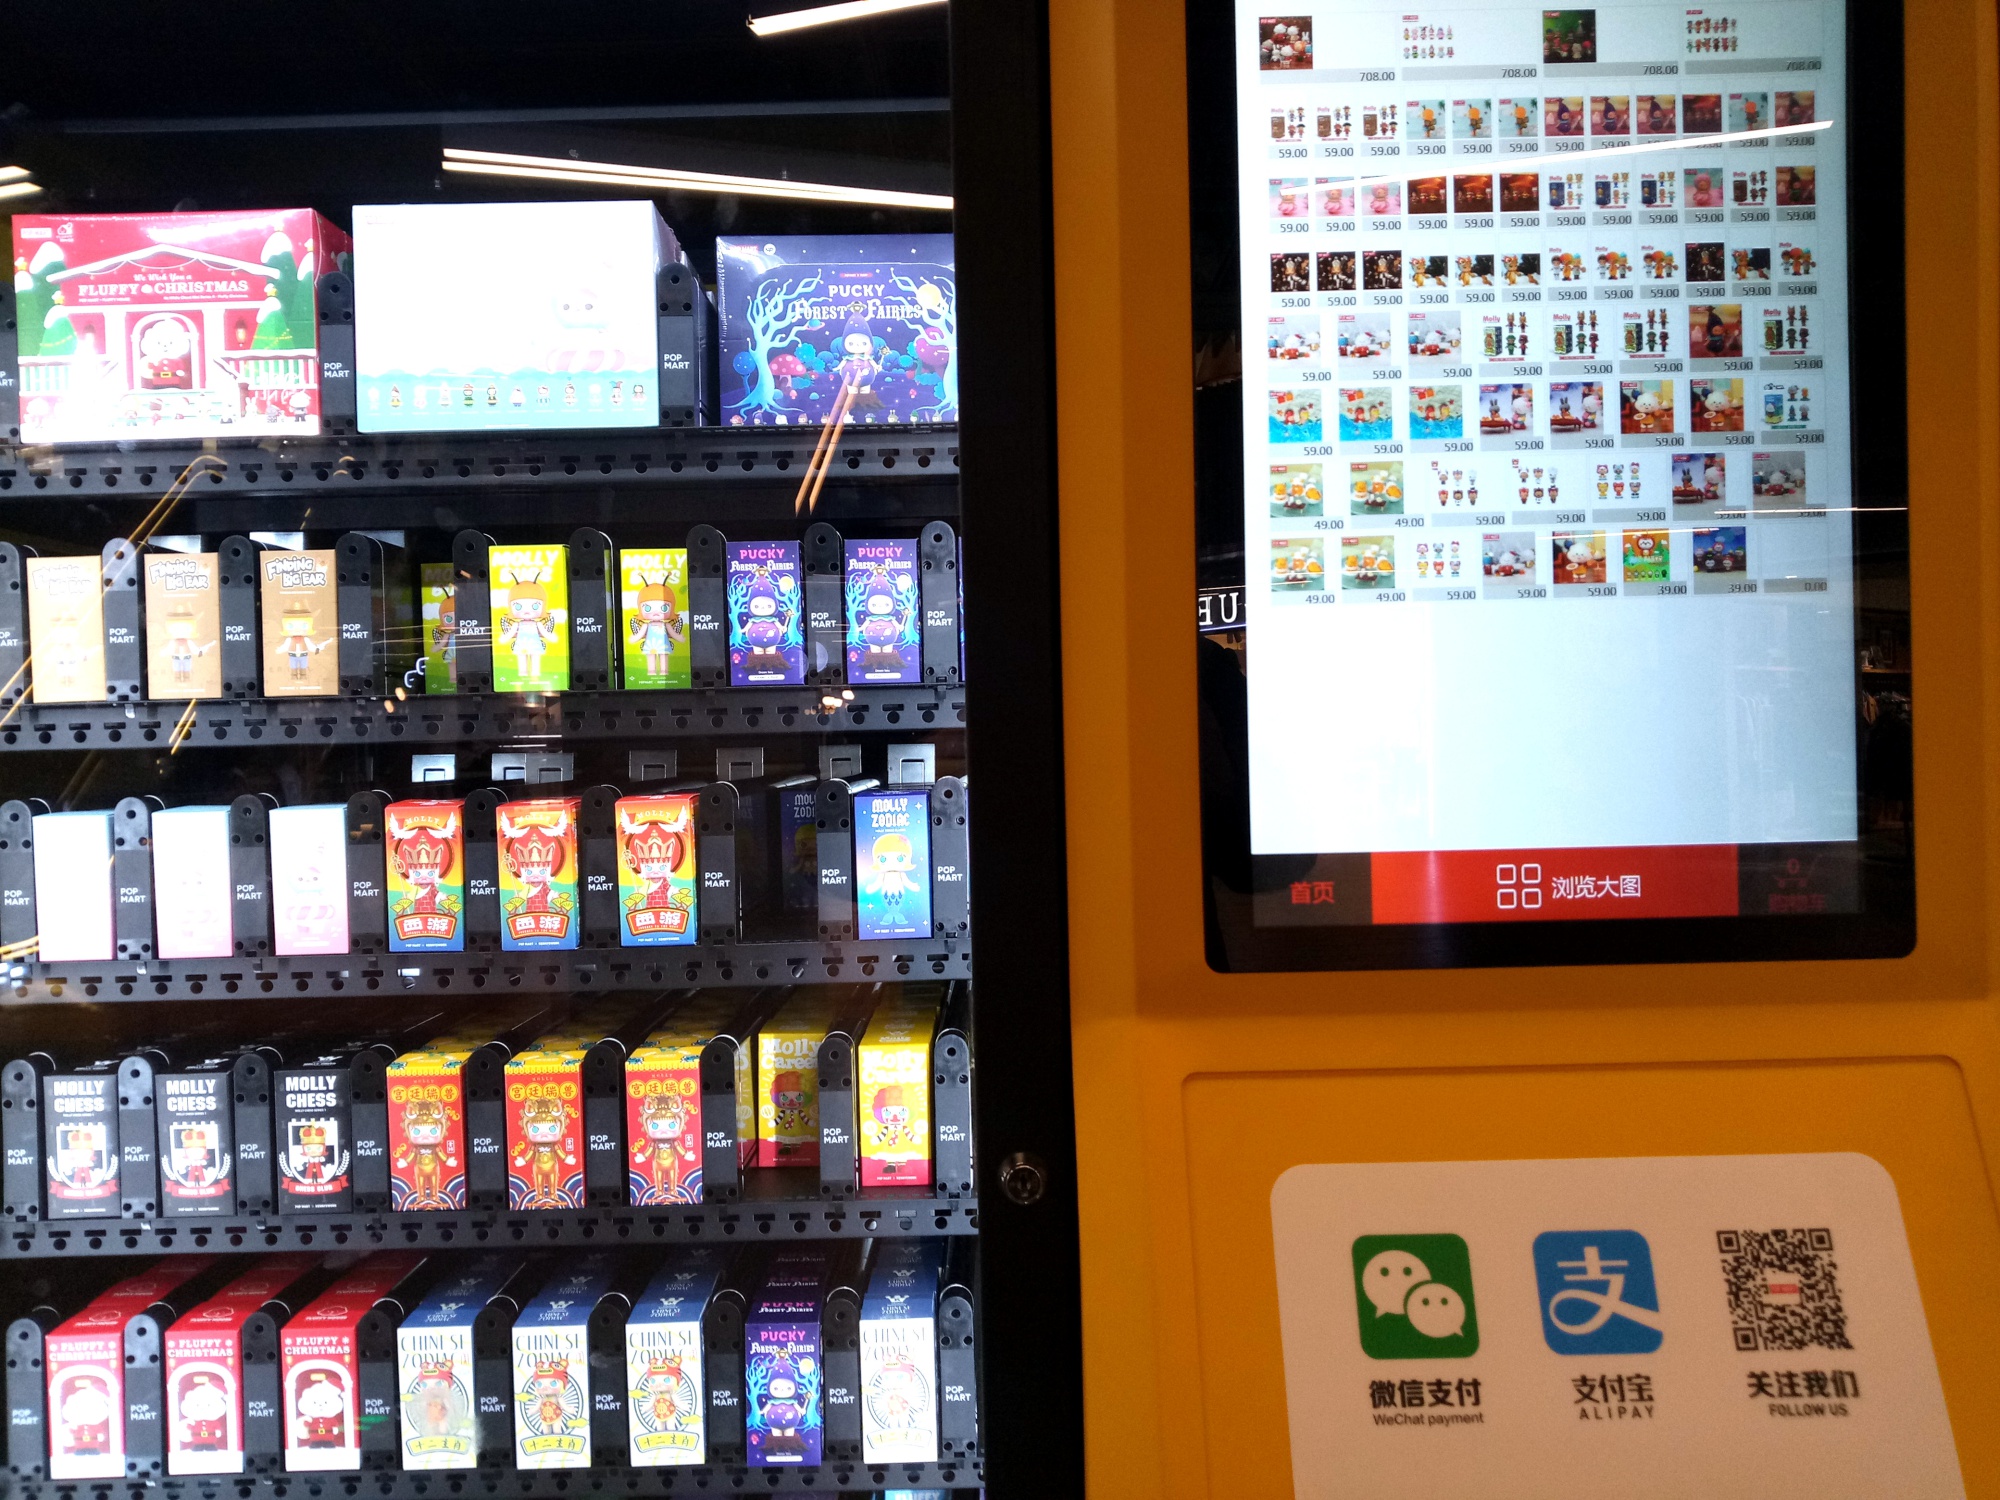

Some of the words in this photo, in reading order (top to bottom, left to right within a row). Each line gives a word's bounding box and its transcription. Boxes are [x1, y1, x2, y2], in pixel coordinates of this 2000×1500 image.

[1643, 65, 1679, 75] 708.00
[1786, 60, 1822, 71] 708.00
[1359, 72, 1395, 82] 708.00
[1501, 68, 1537, 78] 708.00
[1785, 136, 1815, 146] 59.00
[1278, 148, 1308, 158] 59.00
[1417, 145, 1446, 155] 59.00
[1464, 218, 1494, 228] 59.00
[1649, 214, 1678, 224] 59.00
[1280, 223, 1309, 233] 59.00
[78, 284, 139, 296] FLUFFY
[154, 280, 248, 294] CHRISTMAS
[828, 284, 885, 297] PUCKY
[1696, 287, 1725, 297] 59.00
[1281, 297, 1310, 308] 59.00
[1419, 294, 1449, 304] 59.00
[791, 299, 848, 321] FOREST
[866, 298, 923, 321] FAIRIES
[664, 353, 682, 362] POP
[324, 362, 342, 370] POP
[664, 361, 690, 370] MART
[1583, 364, 1613, 374] 59.00
[1794, 359, 1823, 369] 59.00
[324, 370, 349, 379] MART
[1372, 369, 1402, 379] 59.00
[1795, 433, 1824, 443] 59.00
[1514, 440, 1544, 450] 59.00
[1303, 446, 1333, 456] 59.00
[1314, 519, 1344, 530] 49.00
[1394, 517, 1425, 528] 49.00
[739, 549, 785, 559] PUCKY
[858, 547, 902, 558] PUCKY
[491, 551, 558, 567] MOLLY
[621, 553, 687, 569] MOLLY
[730, 560, 757, 572] FOREST
[767, 560, 794, 571] FAIRIES
[848, 558, 875, 571] FOREST
[884, 558, 912, 570] FAIRIES
[185, 574, 210, 589] EAR
[302, 571, 326, 587] EAR
[1658, 585, 1687, 595] 39.00
[1728, 583, 1757, 593] 39.00
[1804, 582, 1827, 592] 0.00
[1376, 592, 1406, 602] 49.00
[1517, 588, 1547, 599] 59.00
[1305, 594, 1335, 604] 49.00
[693, 614, 712, 623] POP
[927, 611, 945, 619] POP
[576, 617, 595, 625] POP
[693, 621, 719, 630] MART
[927, 618, 953, 626] MART
[225, 625, 244, 634] POP
[342, 624, 361, 632] POP
[576, 624, 602, 633] MART
[225, 632, 251, 641] MART
[342, 631, 368, 639] MART
[871, 798, 908, 814] MOLLY
[516, 813, 551, 824] MOLLY
[636, 809, 672, 820] MOLLY
[871, 811, 910, 828] ZODIAC
[405, 814, 440, 826] MOLLY
[704, 872, 723, 880] POP
[821, 869, 840, 877] POP
[470, 879, 489, 888] POP
[704, 879, 730, 888] MART
[821, 876, 847, 885] MART
[120, 887, 139, 896] POP
[236, 884, 255, 893] POP
[470, 886, 496, 895] MART
[1552, 875, 1642, 900] 浏览大图
[236, 891, 262, 900] MART
[1290, 882, 1335, 904] 首页
[120, 894, 146, 903] MART
[762, 1039, 820, 1055] Molly
[862, 1050, 926, 1069] Molly
[53, 1080, 105, 1095] MOLLY
[166, 1079, 216, 1094] MOLLY
[285, 1076, 336, 1091] MOLLY
[53, 1097, 105, 1113] CHESS
[166, 1096, 217, 1111] CHESS
[285, 1093, 336, 1108] CHESS
[706, 1132, 725, 1140] POP
[823, 1128, 842, 1136] POP
[473, 1138, 492, 1146] POP
[706, 1139, 732, 1148] MART
[823, 1135, 849, 1144] MART
[124, 1146, 143, 1155] POP
[240, 1144, 258, 1152] POP
[473, 1145, 499, 1153] MART
[124, 1153, 150, 1162] MART
[240, 1151, 265, 1160] MART
[295, 1335, 339, 1346] FLUFFY
[629, 1330, 692, 1349] CHINESE
[760, 1331, 805, 1342] PUCKY
[61, 1340, 105, 1351] FLUFFY
[179, 1338, 222, 1348] FLUFFY
[400, 1334, 465, 1351] CHINESE
[516, 1333, 579, 1351] CHINESE
[167, 1347, 234, 1358] CHRISTMAS
[285, 1345, 350, 1356] CHRISTMAS
[750, 1343, 778, 1354] FOREST
[788, 1342, 815, 1353] FAIRIES
[49, 1351, 117, 1361] CHRISTMAS
[1571, 1374, 1654, 1404] 支付宝
[1747, 1370, 1860, 1400] 关注我们
[829, 1388, 847, 1397] POP
[1369, 1378, 1482, 1409] 微信支付
[480, 1396, 499, 1405] POP
[595, 1395, 614, 1403] POP
[829, 1395, 855, 1404] MART
[249, 1401, 267, 1409] POP
[480, 1403, 506, 1412] MART
[595, 1402, 621, 1411] MART
[249, 1408, 274, 1417] MART
[1579, 1406, 1655, 1421] ALIPAY
[1768, 1404, 1825, 1417] FOLLOW
[1828, 1404, 1848, 1416] US
[1373, 1413, 1425, 1426] WeChat
[1428, 1412, 1484, 1427] payment
